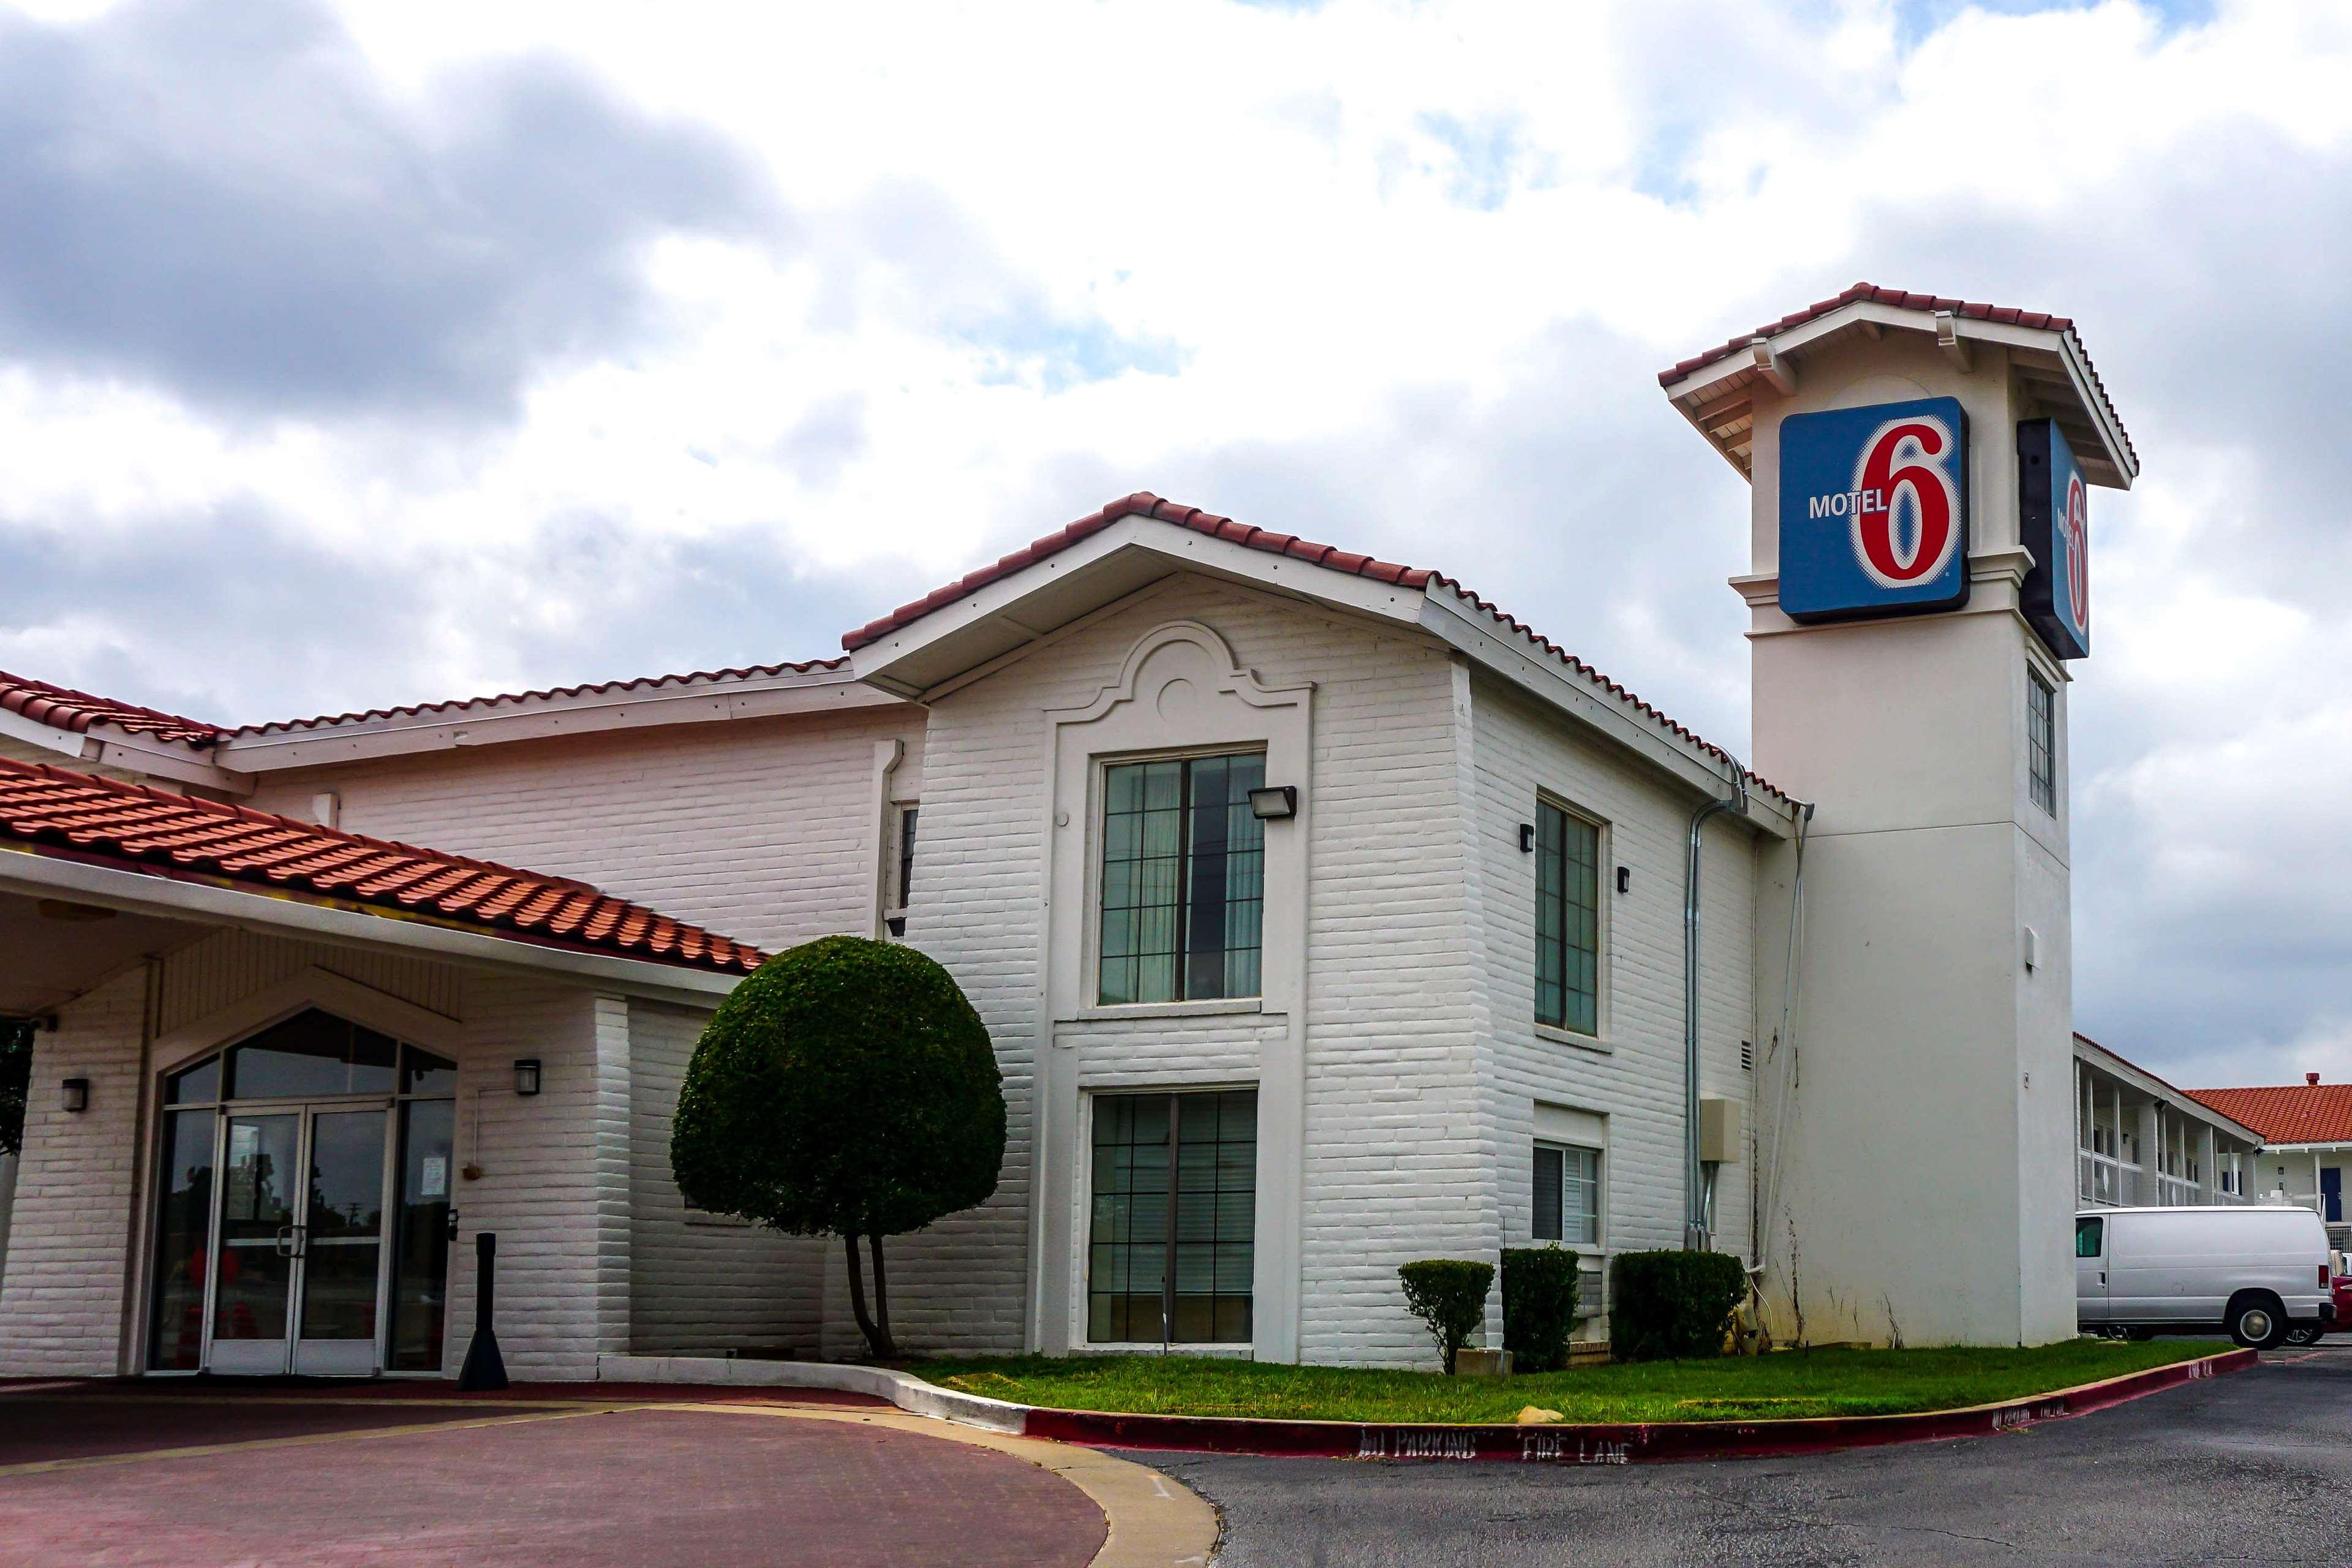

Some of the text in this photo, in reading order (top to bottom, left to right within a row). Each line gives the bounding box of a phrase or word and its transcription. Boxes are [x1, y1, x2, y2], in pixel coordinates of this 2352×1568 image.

[1809, 423, 1950, 581] MOTEL 6
[2068, 478, 2087, 627] 6
[1394, 1429, 1476, 1459] PARKING
